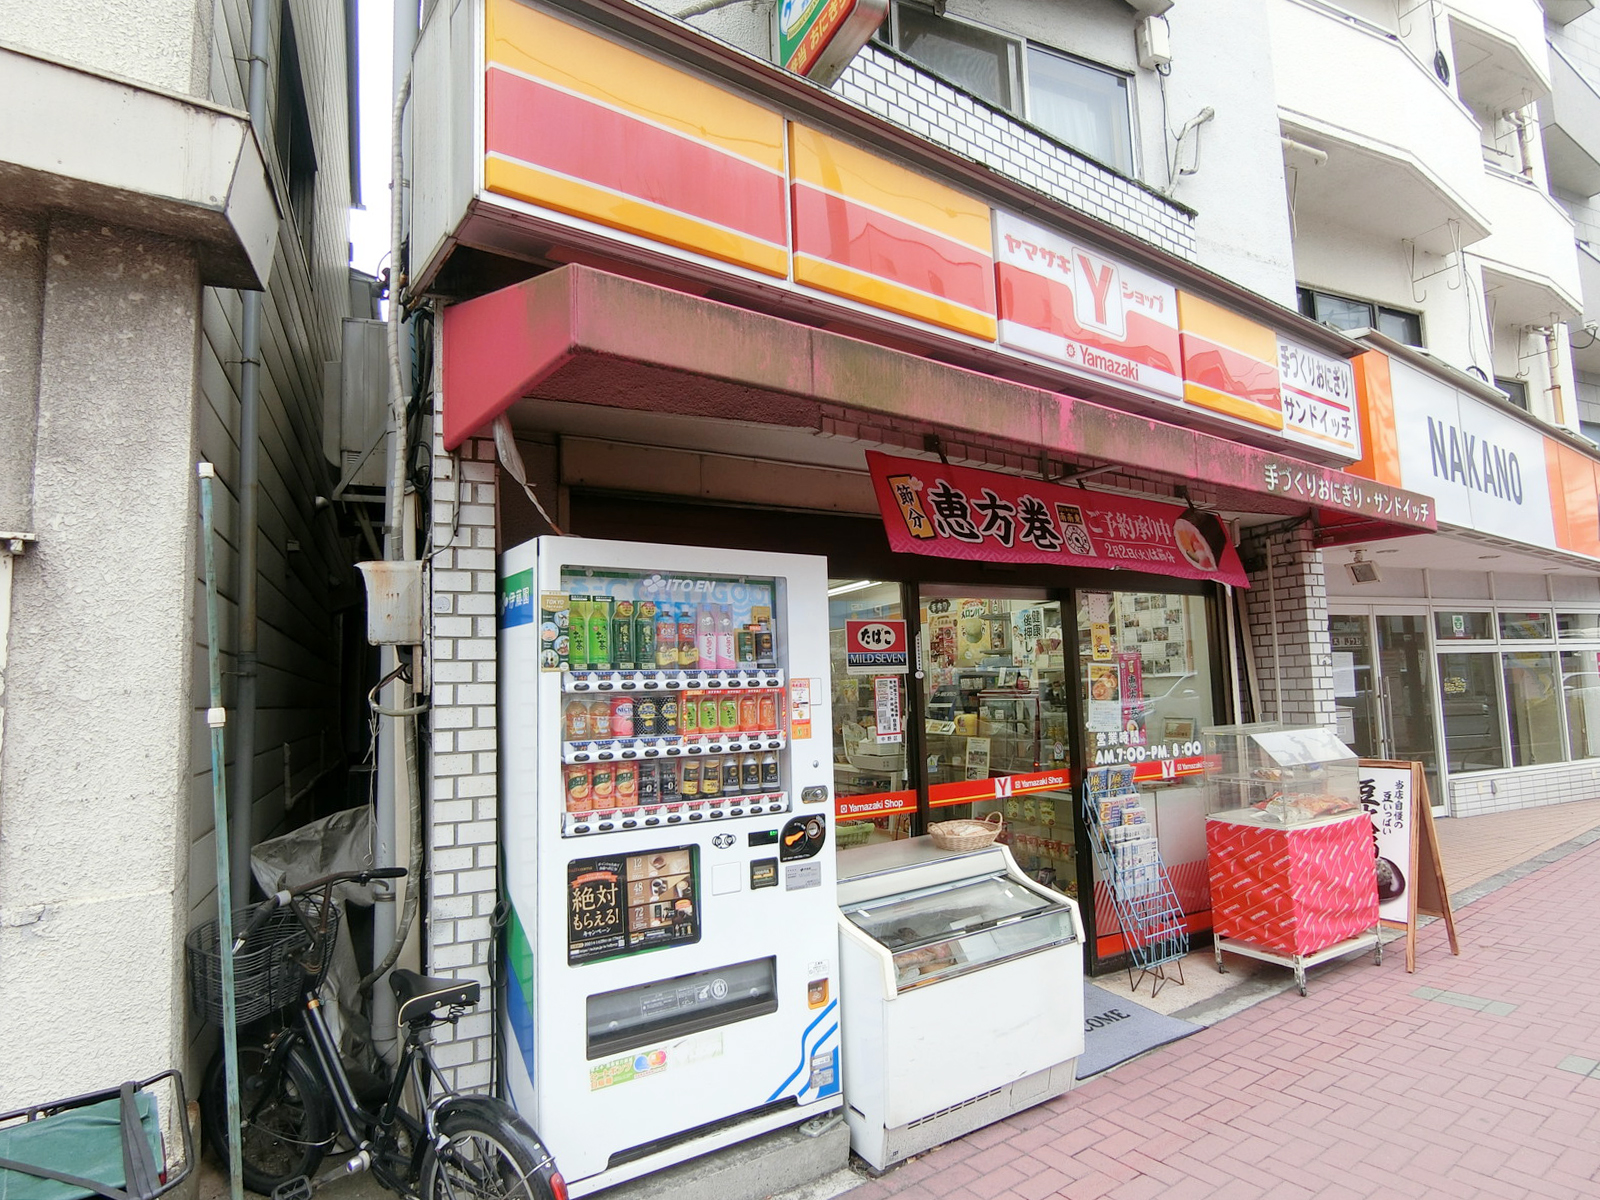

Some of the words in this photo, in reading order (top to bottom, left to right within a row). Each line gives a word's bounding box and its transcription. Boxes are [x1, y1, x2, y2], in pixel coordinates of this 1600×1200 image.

[1004, 232, 1072, 275] ヤマザキ
[1121, 280, 1165, 314] ショップ
[1078, 344, 1140, 383] Yamazaki
[1280, 345, 1350, 399] 手づくりおにぎり
[1283, 396, 1352, 440] サンドイッチ
[1427, 415, 1523, 506] NAKANO
[896, 484, 926, 530] 節分
[930, 480, 1061, 551] 恵方巻
[1086, 509, 1172, 544] ご予約承り中
[666, 579, 694, 592] ITO
[694, 580, 716, 593] EN
[861, 628, 891, 645] たばこ
[850, 653, 875, 664] MILD
[876, 653, 904, 664] SEVEN
[1097, 731, 1140, 747] 営業時間
[1021, 777, 1048, 788] Yamazaki
[1048, 775, 1063, 785] Shop
[848, 800, 883, 812] Yamazaki
[884, 798, 903, 809] Shop
[1394, 780, 1405, 829] 当店自慢の
[572, 882, 619, 913] 絶対
